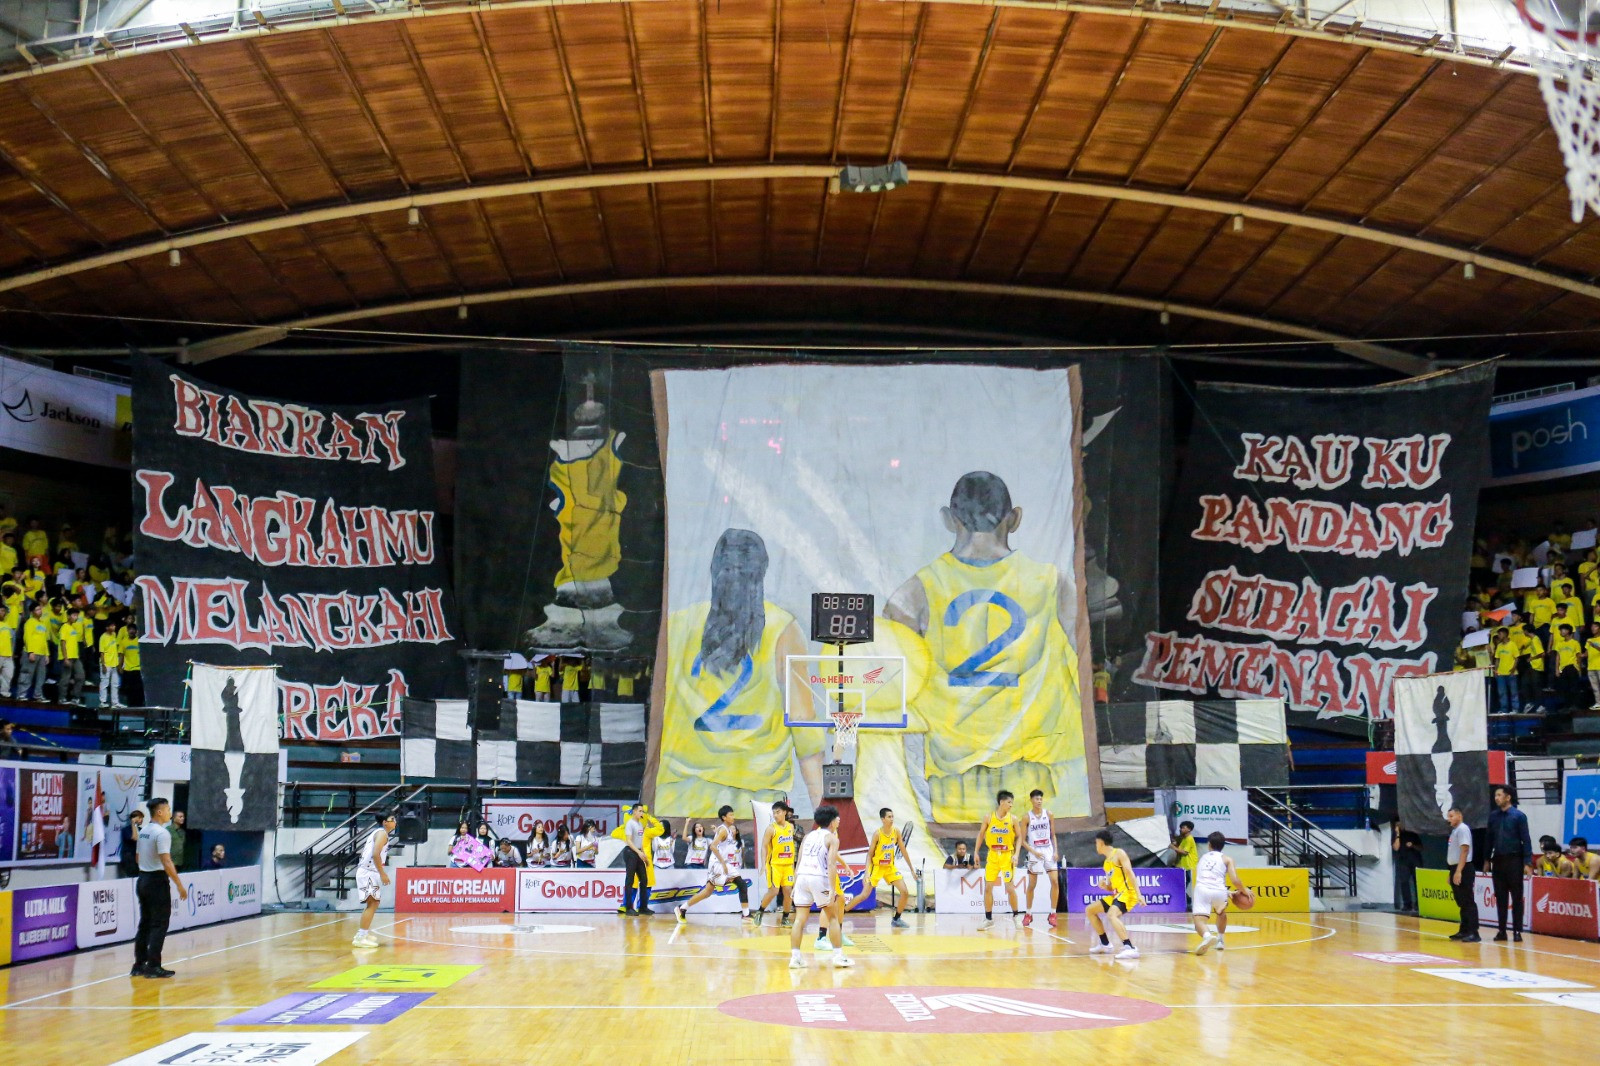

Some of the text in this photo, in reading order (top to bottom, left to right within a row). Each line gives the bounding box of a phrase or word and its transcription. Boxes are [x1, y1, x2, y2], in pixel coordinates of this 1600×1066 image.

[40, 402, 101, 428] Jackson
[169, 373, 406, 471] BIARKAN
[1512, 408, 1588, 468] posh
[1233, 432, 1451, 490] KAU KU
[135, 469, 434, 568] LANGKAHMU
[1191, 494, 1453, 558] PANDANG
[134, 574, 454, 654] MELANGKAHI
[1186, 565, 1439, 651] SEBAGAI
[944, 589, 1027, 687] 2
[810, 675, 826, 684] One
[32, 796, 62, 816] CREAM
[1184, 804, 1230, 815] RS UBAYA
[94, 905, 115, 926] Bioré
[541, 880, 588, 898] Good
[1548, 900, 1593, 918] HONDA
